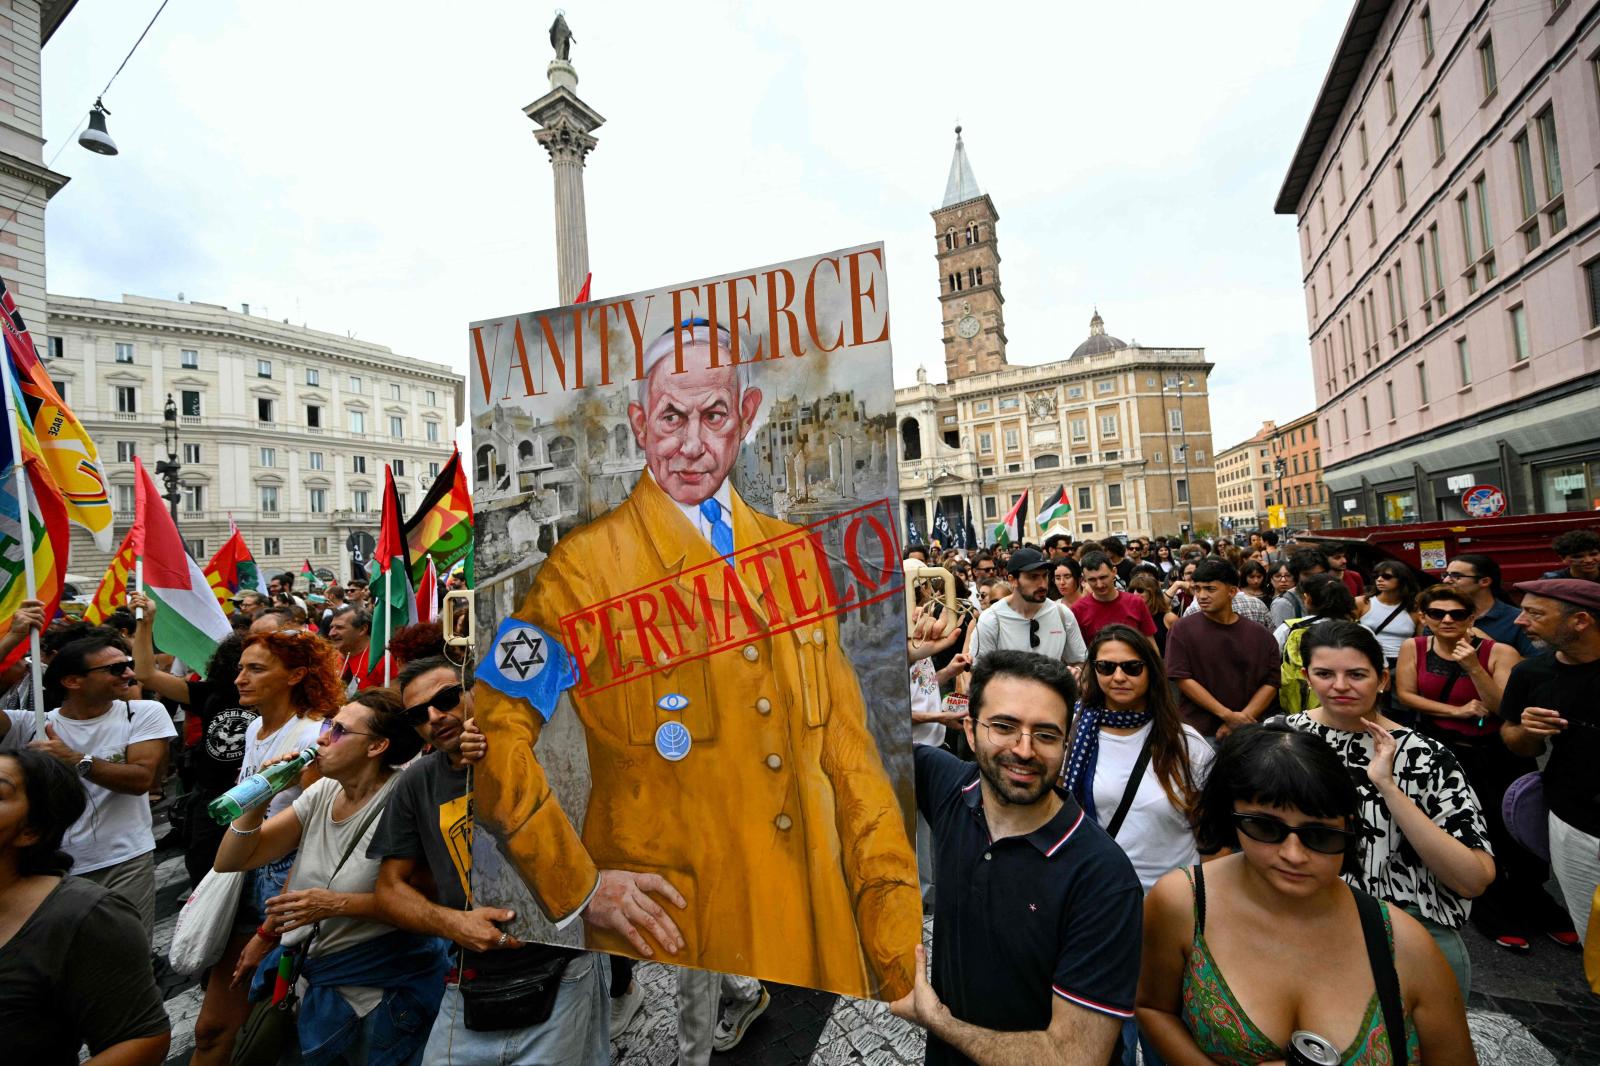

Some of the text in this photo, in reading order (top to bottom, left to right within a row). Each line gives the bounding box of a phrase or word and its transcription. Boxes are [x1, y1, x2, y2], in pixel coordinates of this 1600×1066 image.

[469, 248, 889, 405] VANITY FIERCE
[563, 513, 896, 693] FERMATELO
